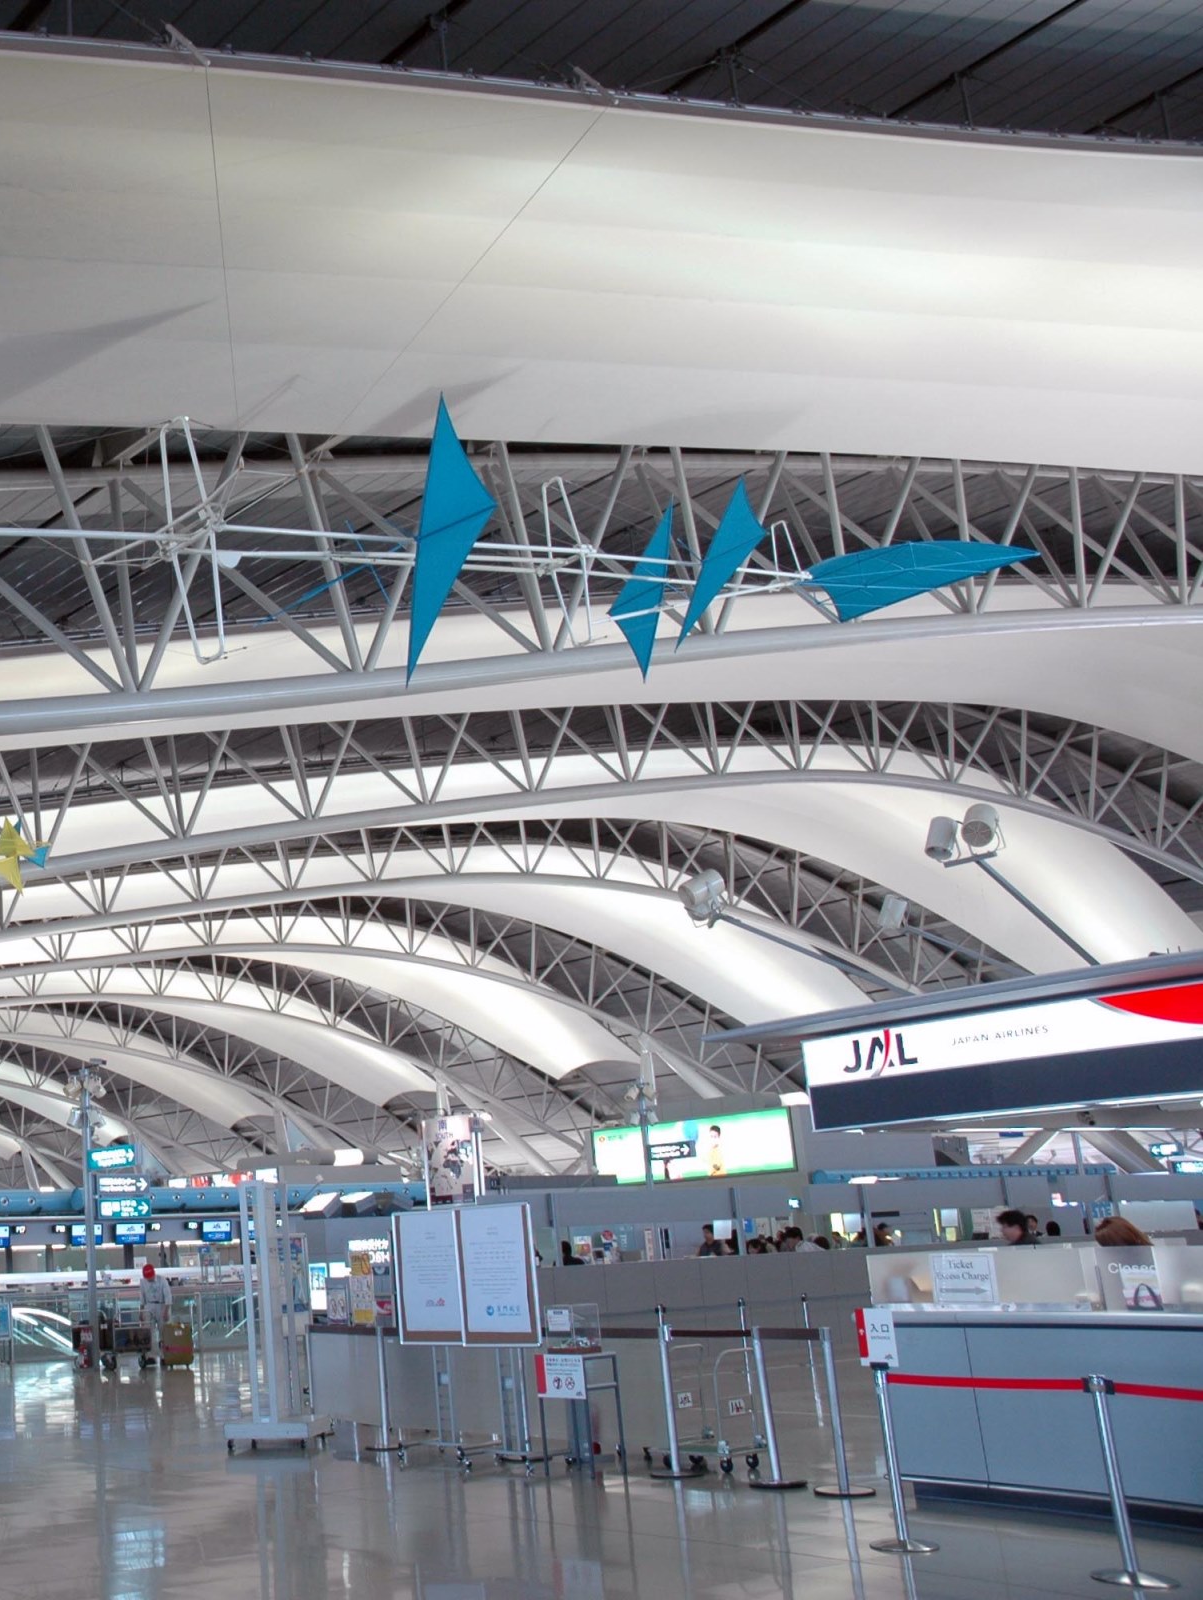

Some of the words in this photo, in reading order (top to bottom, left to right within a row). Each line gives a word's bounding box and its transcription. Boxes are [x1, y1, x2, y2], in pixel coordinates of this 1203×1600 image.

[952, 1034, 990, 1046] JAPAN
[995, 1025, 1049, 1039] AIRLINES
[843, 1029, 918, 1077] JAL
[947, 1259, 973, 1269] Ticket
[961, 1271, 989, 1282] Charge
[870, 1323, 890, 1333] 入口
